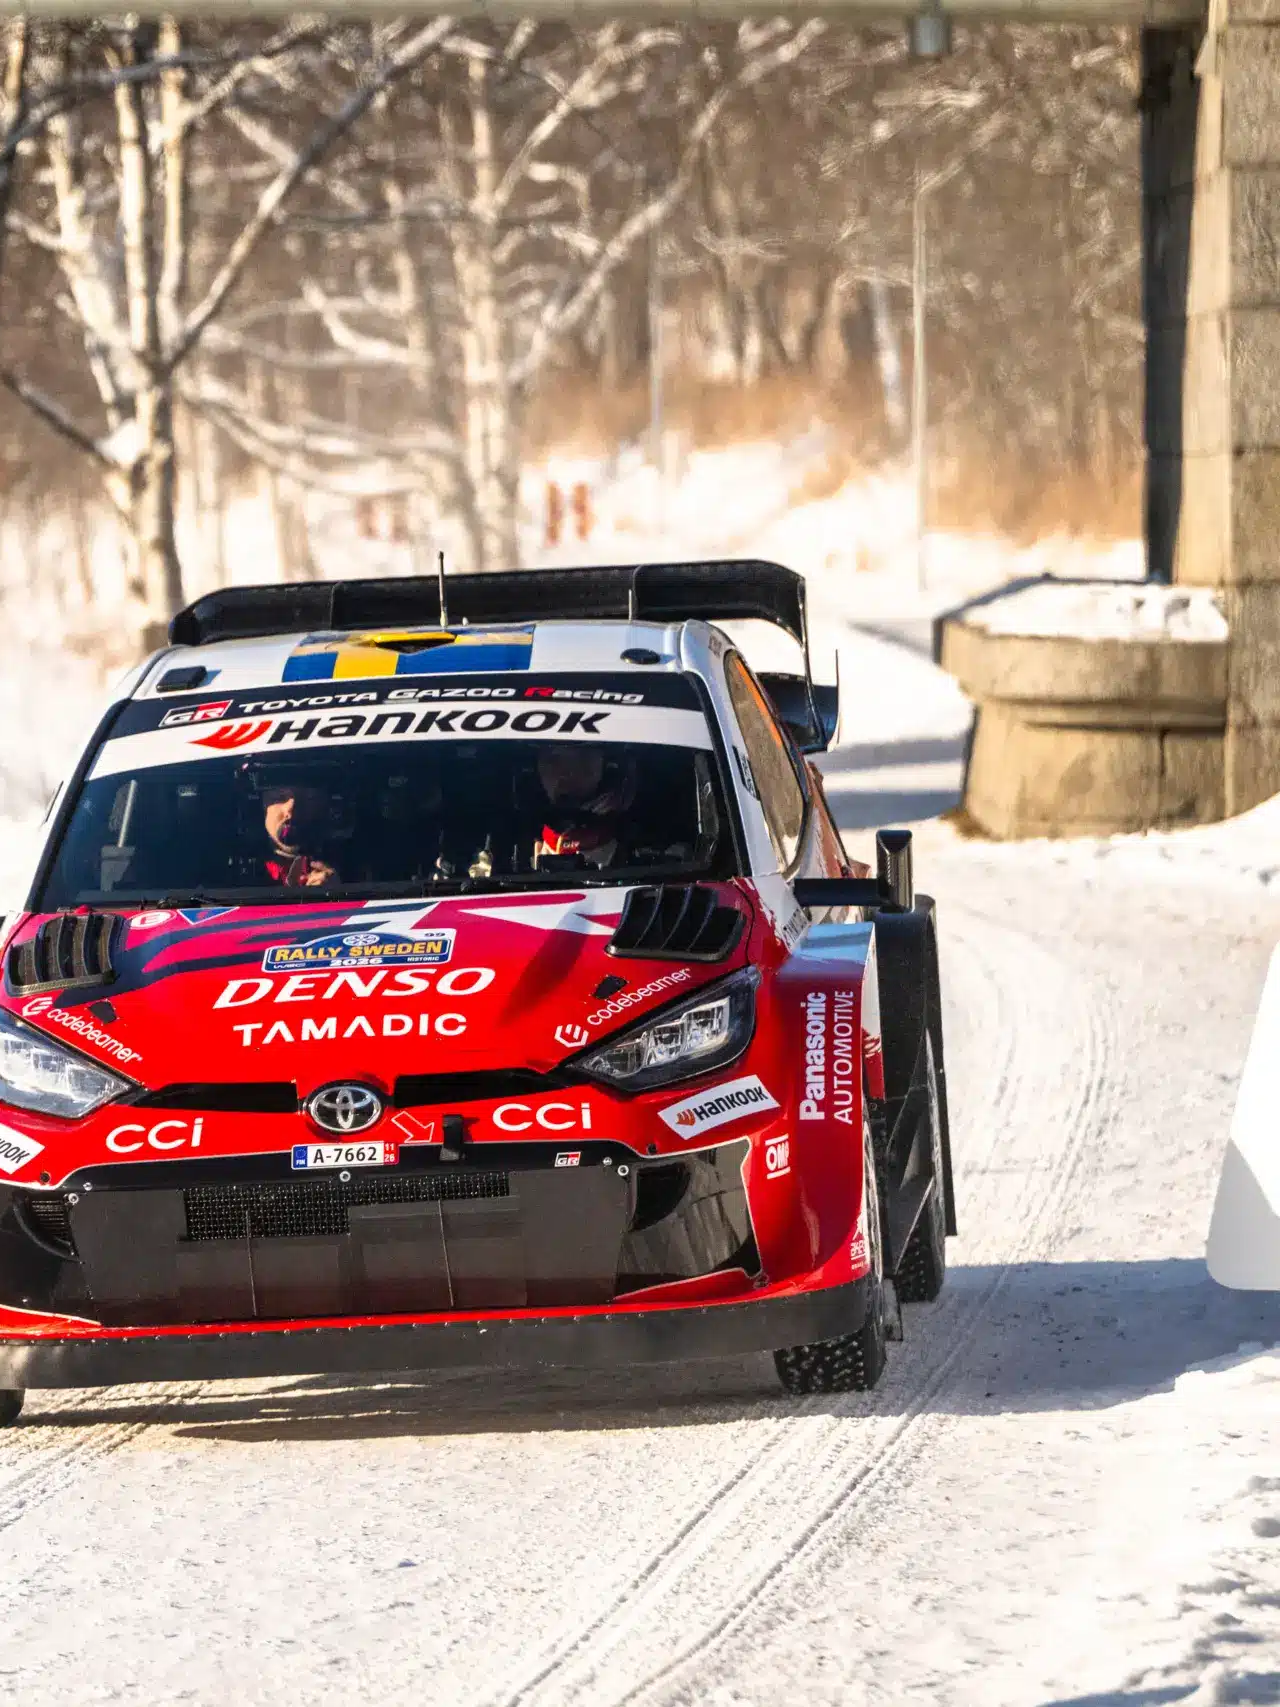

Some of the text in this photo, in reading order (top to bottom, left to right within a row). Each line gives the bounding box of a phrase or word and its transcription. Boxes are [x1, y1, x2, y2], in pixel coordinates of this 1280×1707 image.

[163, 687, 644, 725] GR TOYOTA GAZOO Racing
[275, 939, 443, 962] RALLY SWEDEN
[329, 957, 383, 967] 2026
[212, 967, 496, 1009] DENSO
[586, 968, 690, 1026] codebeamer
[46, 1008, 140, 1063] codebeamer
[232, 1013, 467, 1047] TAMADIC
[799, 992, 826, 1120] Panasonic
[833, 990, 854, 1125] AUTOMOTIVE
[313, 1146, 377, 1163] A-7662
[384, 1143, 395, 1151] 11
[384, 1154, 395, 1162] 26
